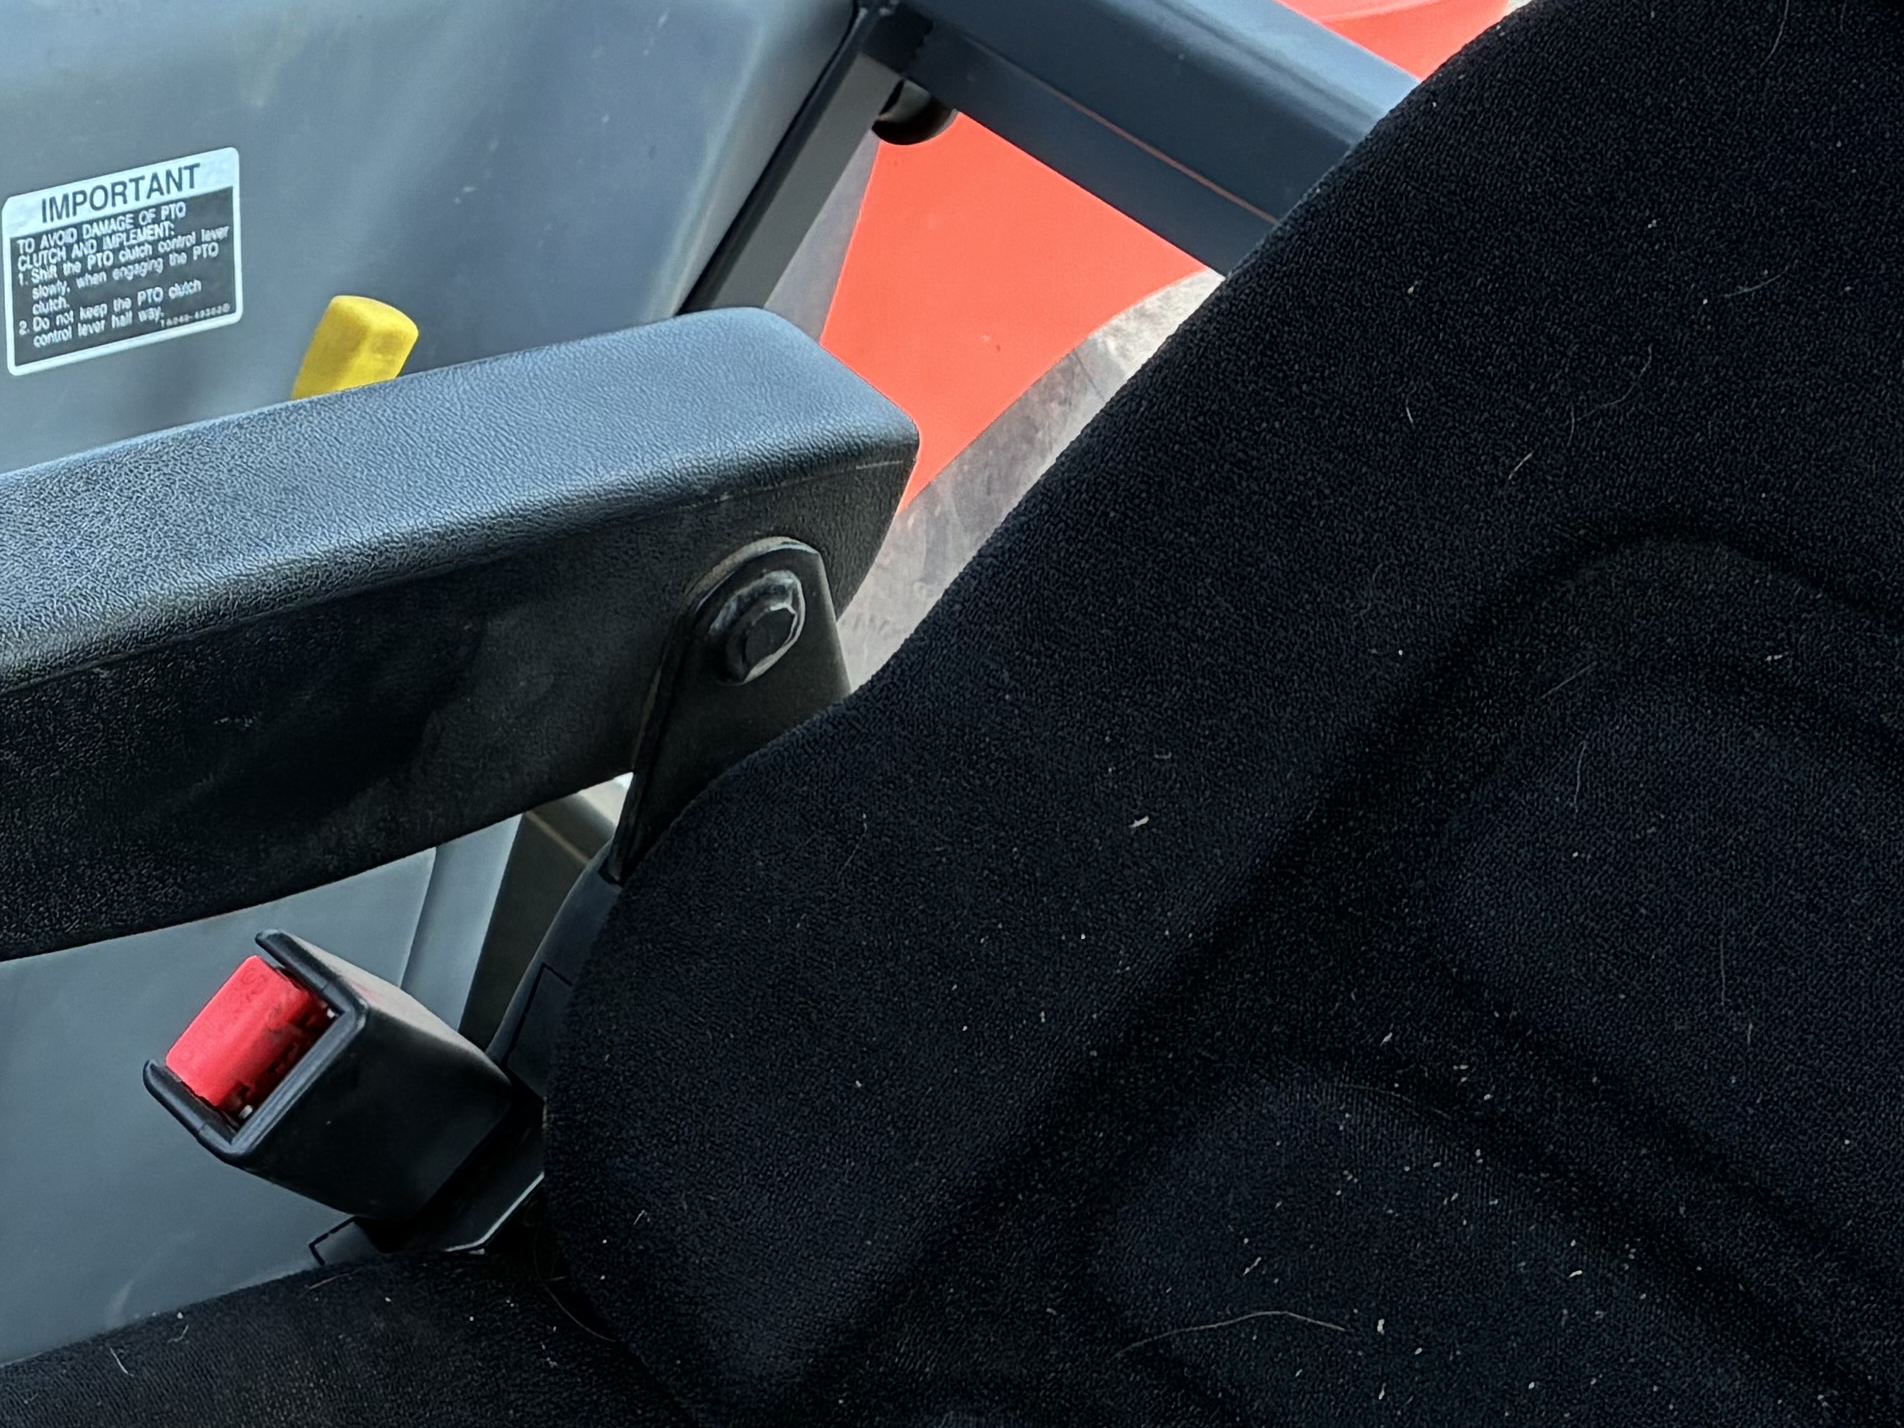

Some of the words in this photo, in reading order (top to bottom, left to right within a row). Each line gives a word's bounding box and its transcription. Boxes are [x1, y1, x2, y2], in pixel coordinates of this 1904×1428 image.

[41, 162, 201, 223] IMPORTANT
[17, 238, 35, 254] TO
[40, 228, 77, 248] AVOID
[82, 215, 134, 238] DAMAGE
[139, 208, 156, 225] OF
[160, 201, 187, 221] PTO
[17, 247, 66, 271] CLUTCH
[72, 239, 97, 258] AND
[102, 221, 175, 250] IMPLEMENT:
[18, 273, 29, 286] 1.
[31, 265, 58, 284] Shift
[63, 261, 82, 276] the
[87, 252, 114, 270] PTO
[119, 243, 152, 262] clutch
[158, 230, 196, 252] control
[201, 225, 230, 242] lever
[32, 279, 71, 300] slowly,
[76, 271, 107, 288] when
[112, 257, 164, 281] engaging
[169, 251, 187, 267] the
[193, 242, 220, 261] PTO
[19, 320, 30, 336] 2.
[33, 316, 50, 332] Do
[56, 311, 74, 326] not
[80, 303, 108, 321] keep
[113, 297, 132, 312] the
[137, 286, 164, 306] PTO
[168, 279, 202, 299] clutch
[32, 297, 70, 315] clutch.
[33, 328, 72, 348] control
[78, 319, 106, 337] lever
[112, 311, 133, 329] half
[138, 306, 165, 323] way.
